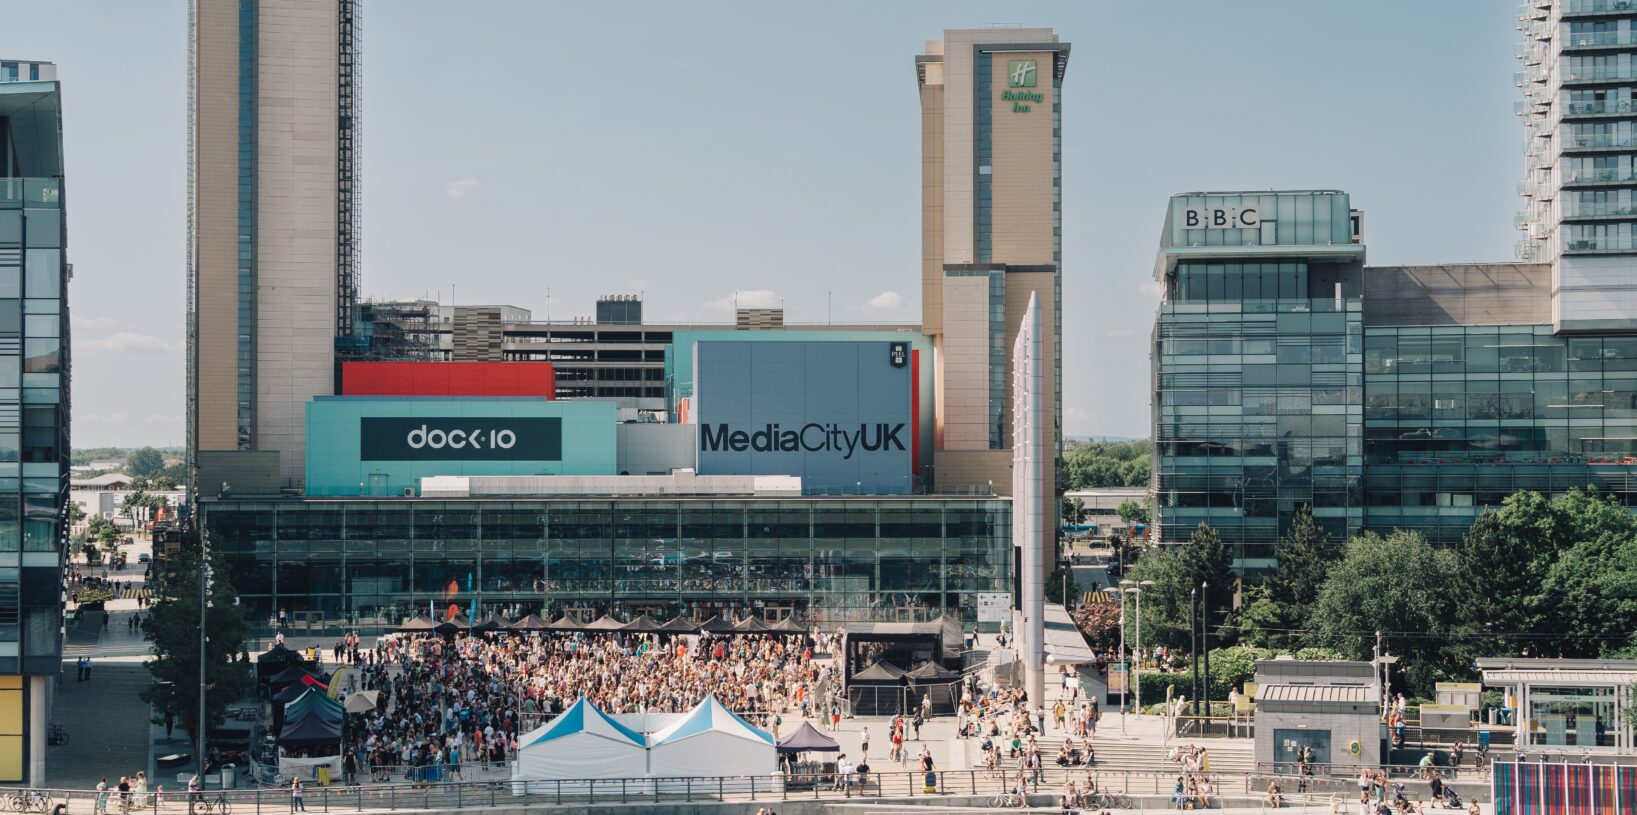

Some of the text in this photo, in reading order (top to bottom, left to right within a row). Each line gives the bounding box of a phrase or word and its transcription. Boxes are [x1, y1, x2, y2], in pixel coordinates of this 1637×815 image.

[1001, 90, 1043, 103] Holiday
[1012, 102, 1031, 113] Inn
[1186, 208, 1257, 226] BBC
[701, 423, 906, 460] MediaCityUK
